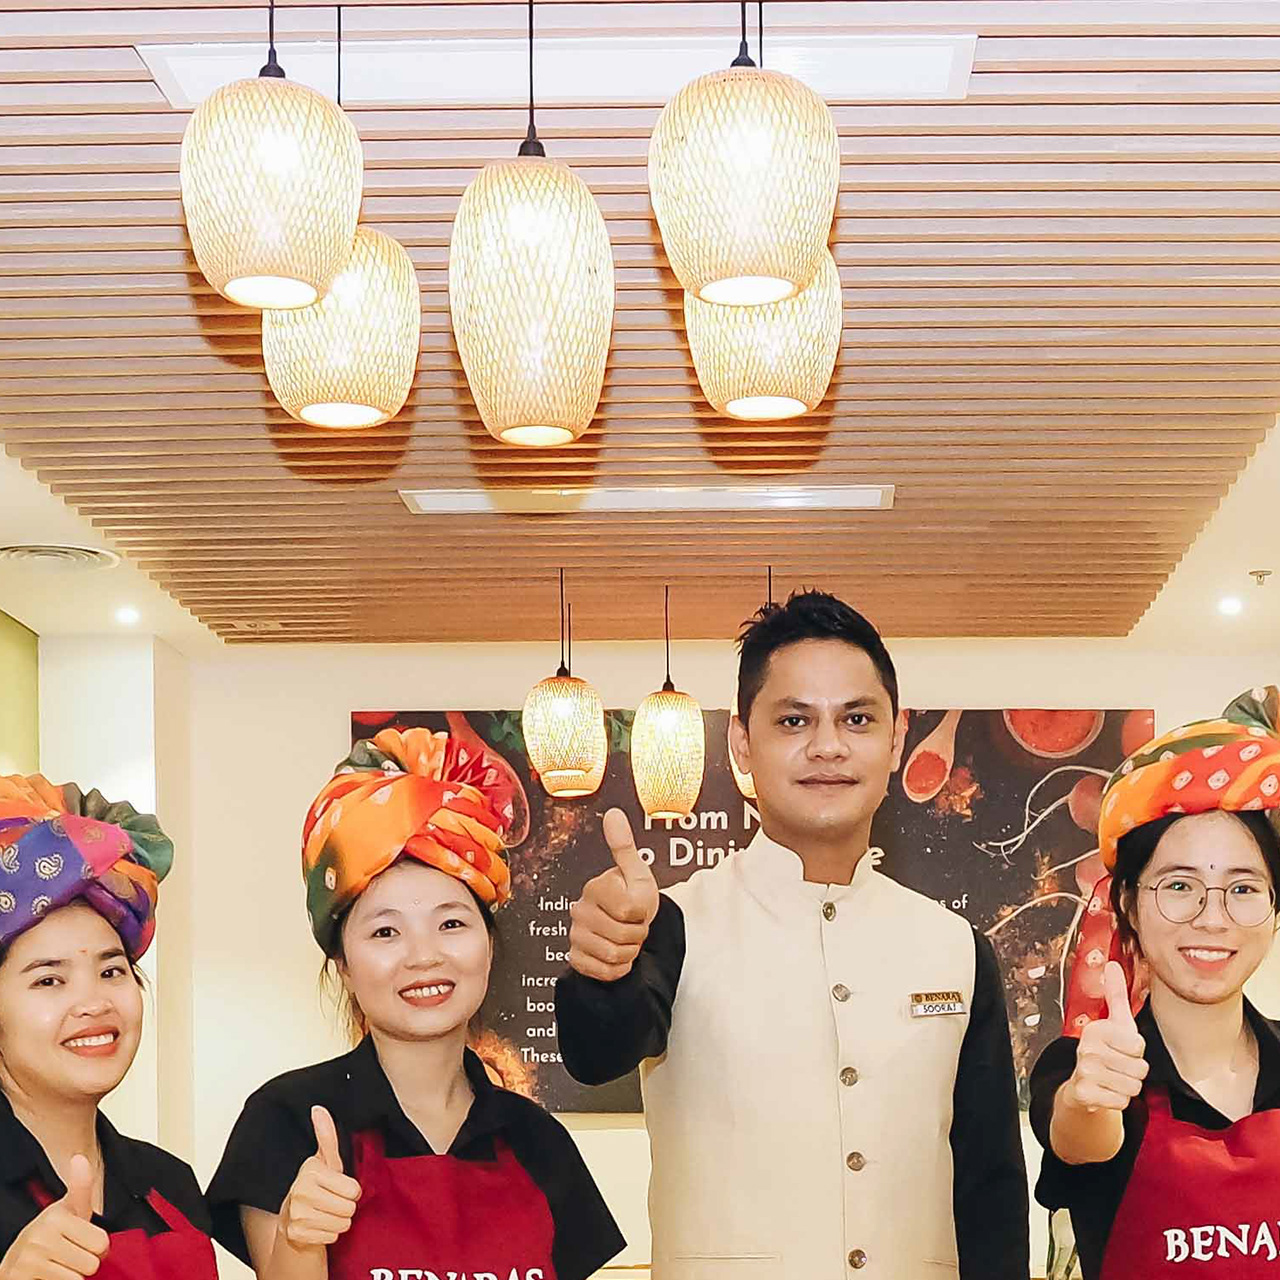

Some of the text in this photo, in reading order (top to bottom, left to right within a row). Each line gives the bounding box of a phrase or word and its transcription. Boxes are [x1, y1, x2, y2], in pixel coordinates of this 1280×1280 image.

[951, 893, 969, 909] of
[528, 920, 568, 936] fresh
[526, 1021, 556, 1037] and
